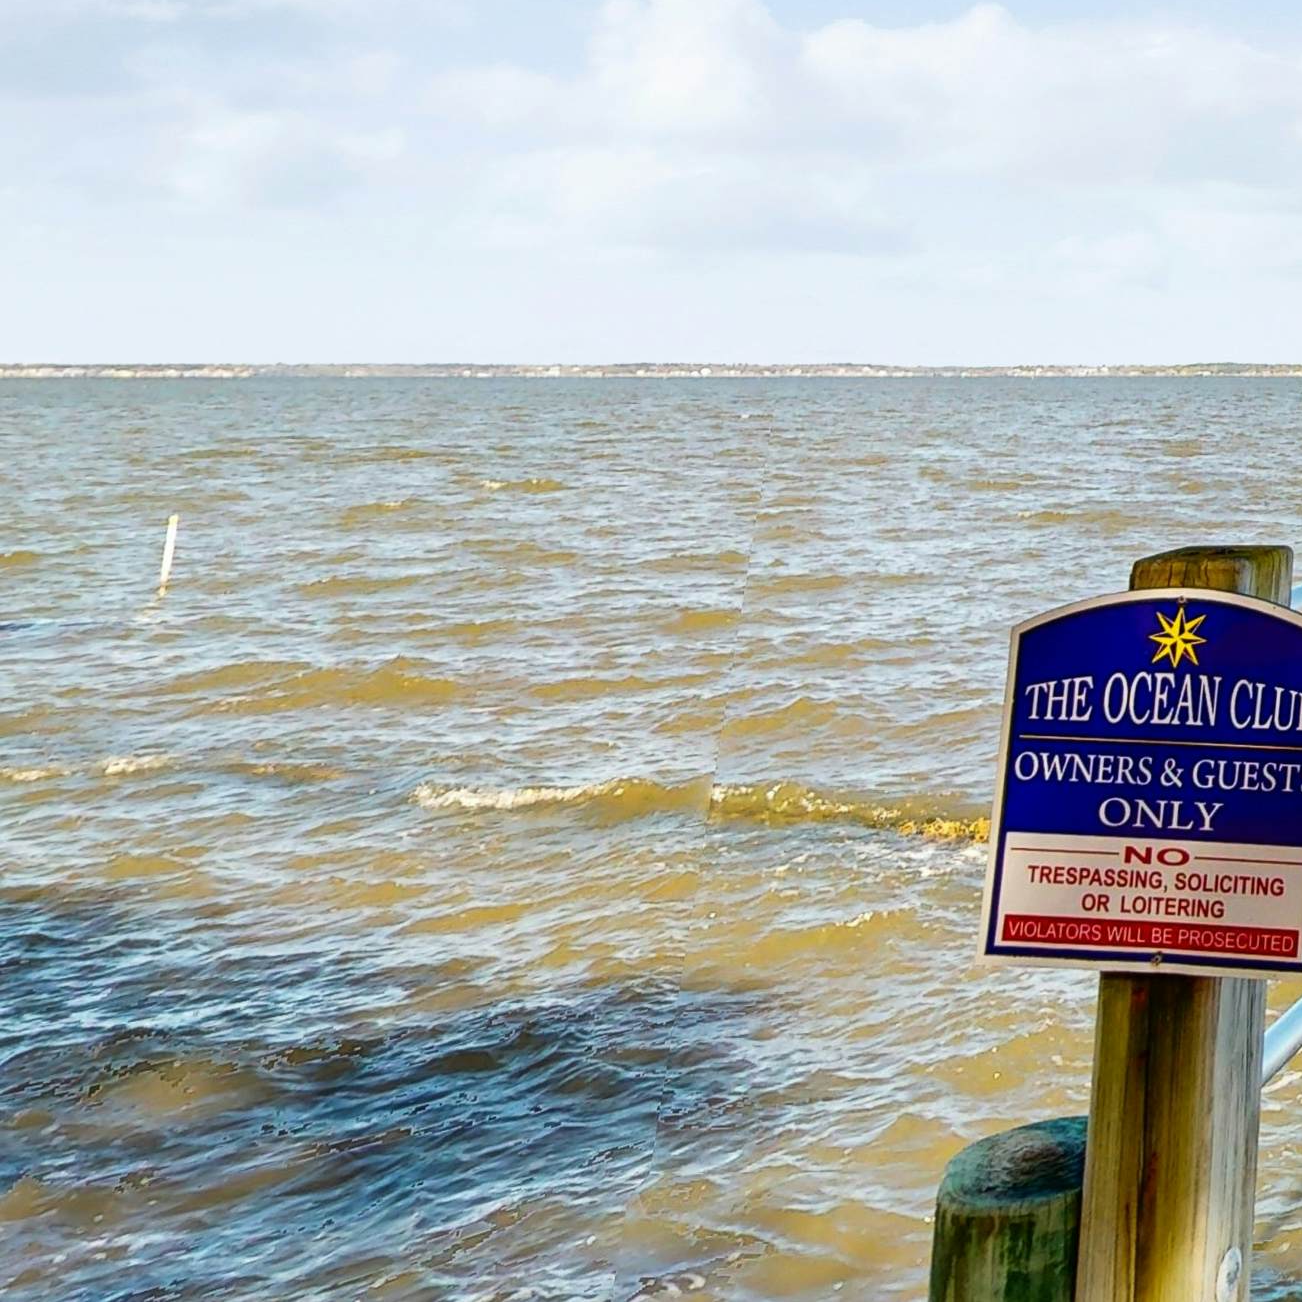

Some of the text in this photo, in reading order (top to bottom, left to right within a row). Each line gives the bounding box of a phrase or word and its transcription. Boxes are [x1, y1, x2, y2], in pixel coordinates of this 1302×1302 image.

[1025, 675, 1094, 721] THE
[1103, 671, 1223, 726] OCEAN
[1014, 751, 1152, 786] OWNERS
[1160, 758, 1183, 788] &
[1098, 797, 1224, 831] ONLY
[1123, 845, 1190, 866] NO
[1027, 865, 1285, 896] TRESPASSING, SOLICITING
[1081, 893, 1225, 918] OR LOITERING
[1008, 920, 1294, 952] VIOLATORS WILL BE PROSECUTED
